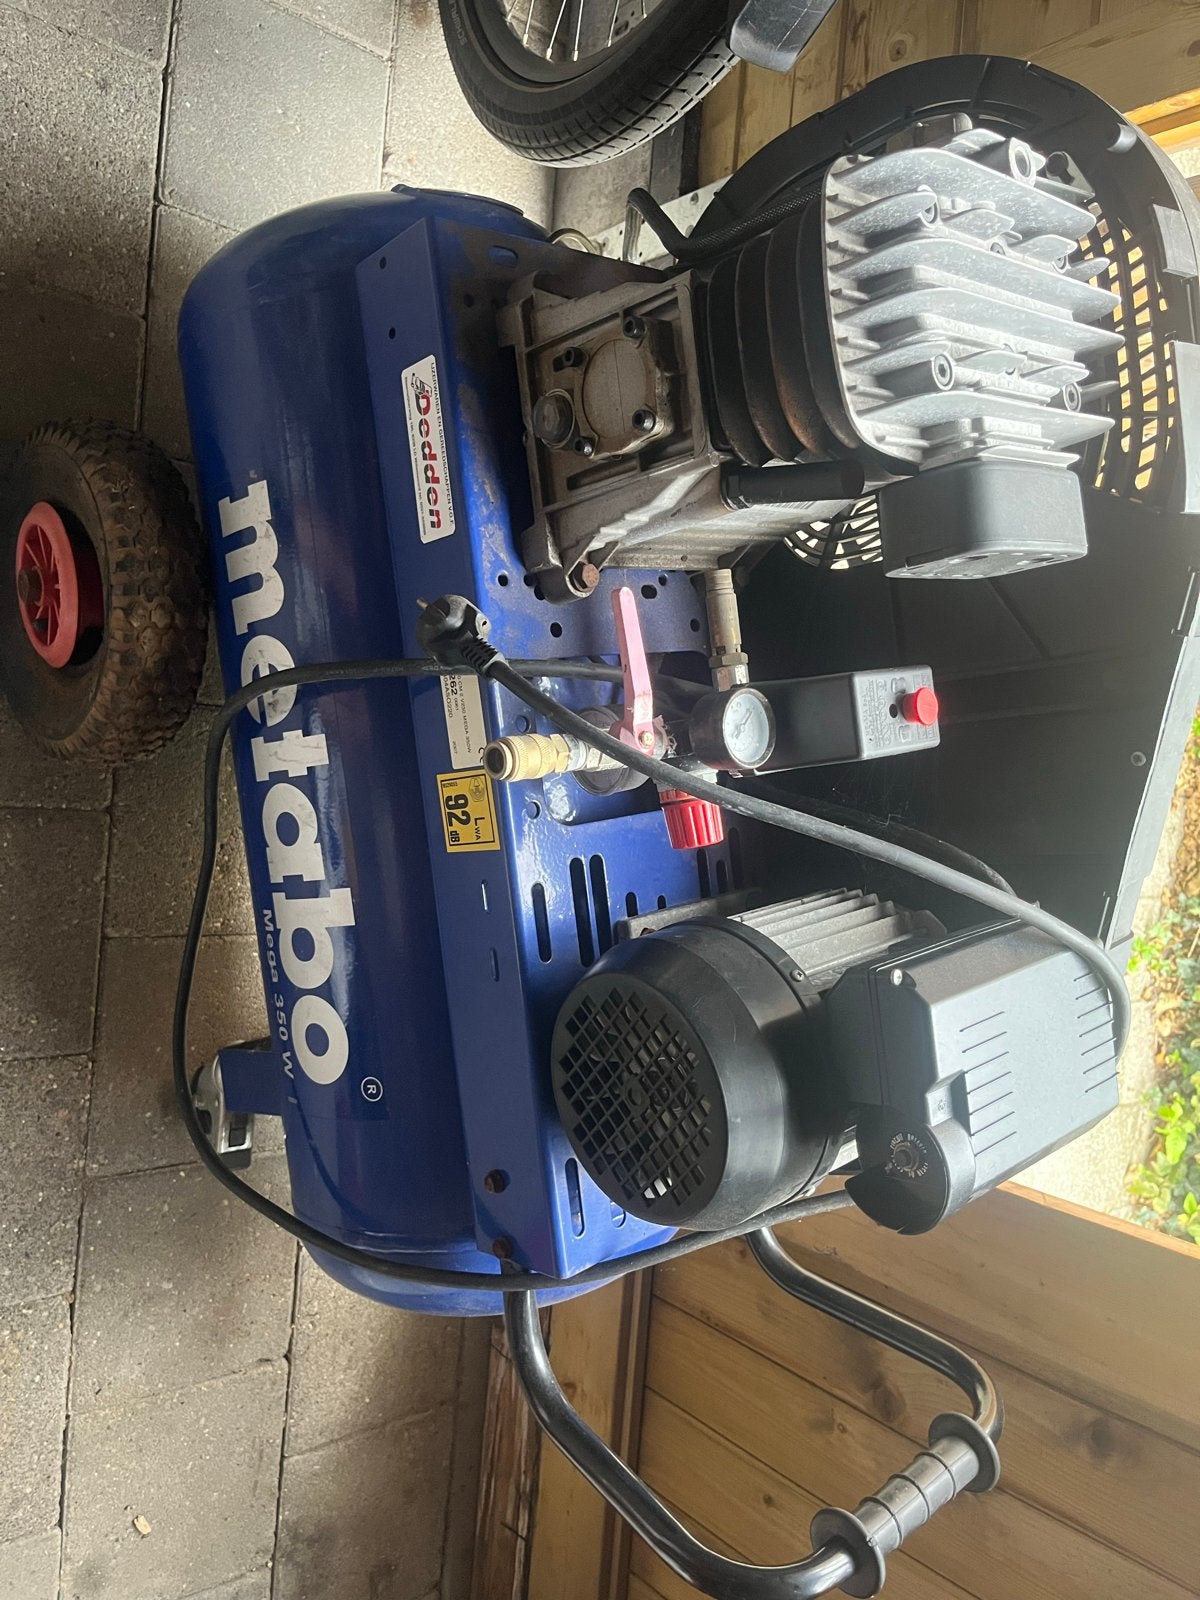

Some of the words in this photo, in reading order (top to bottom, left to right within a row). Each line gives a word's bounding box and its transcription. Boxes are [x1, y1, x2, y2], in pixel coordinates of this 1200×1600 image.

[415, 392, 442, 529] Dedden
[219, 480, 356, 1085] metabo
[445, 793, 471, 827] 92
[450, 830, 460, 843] dB
[263, 909, 279, 983] Mega
[273, 993, 289, 1041] 350
[282, 1051, 295, 1079] W
